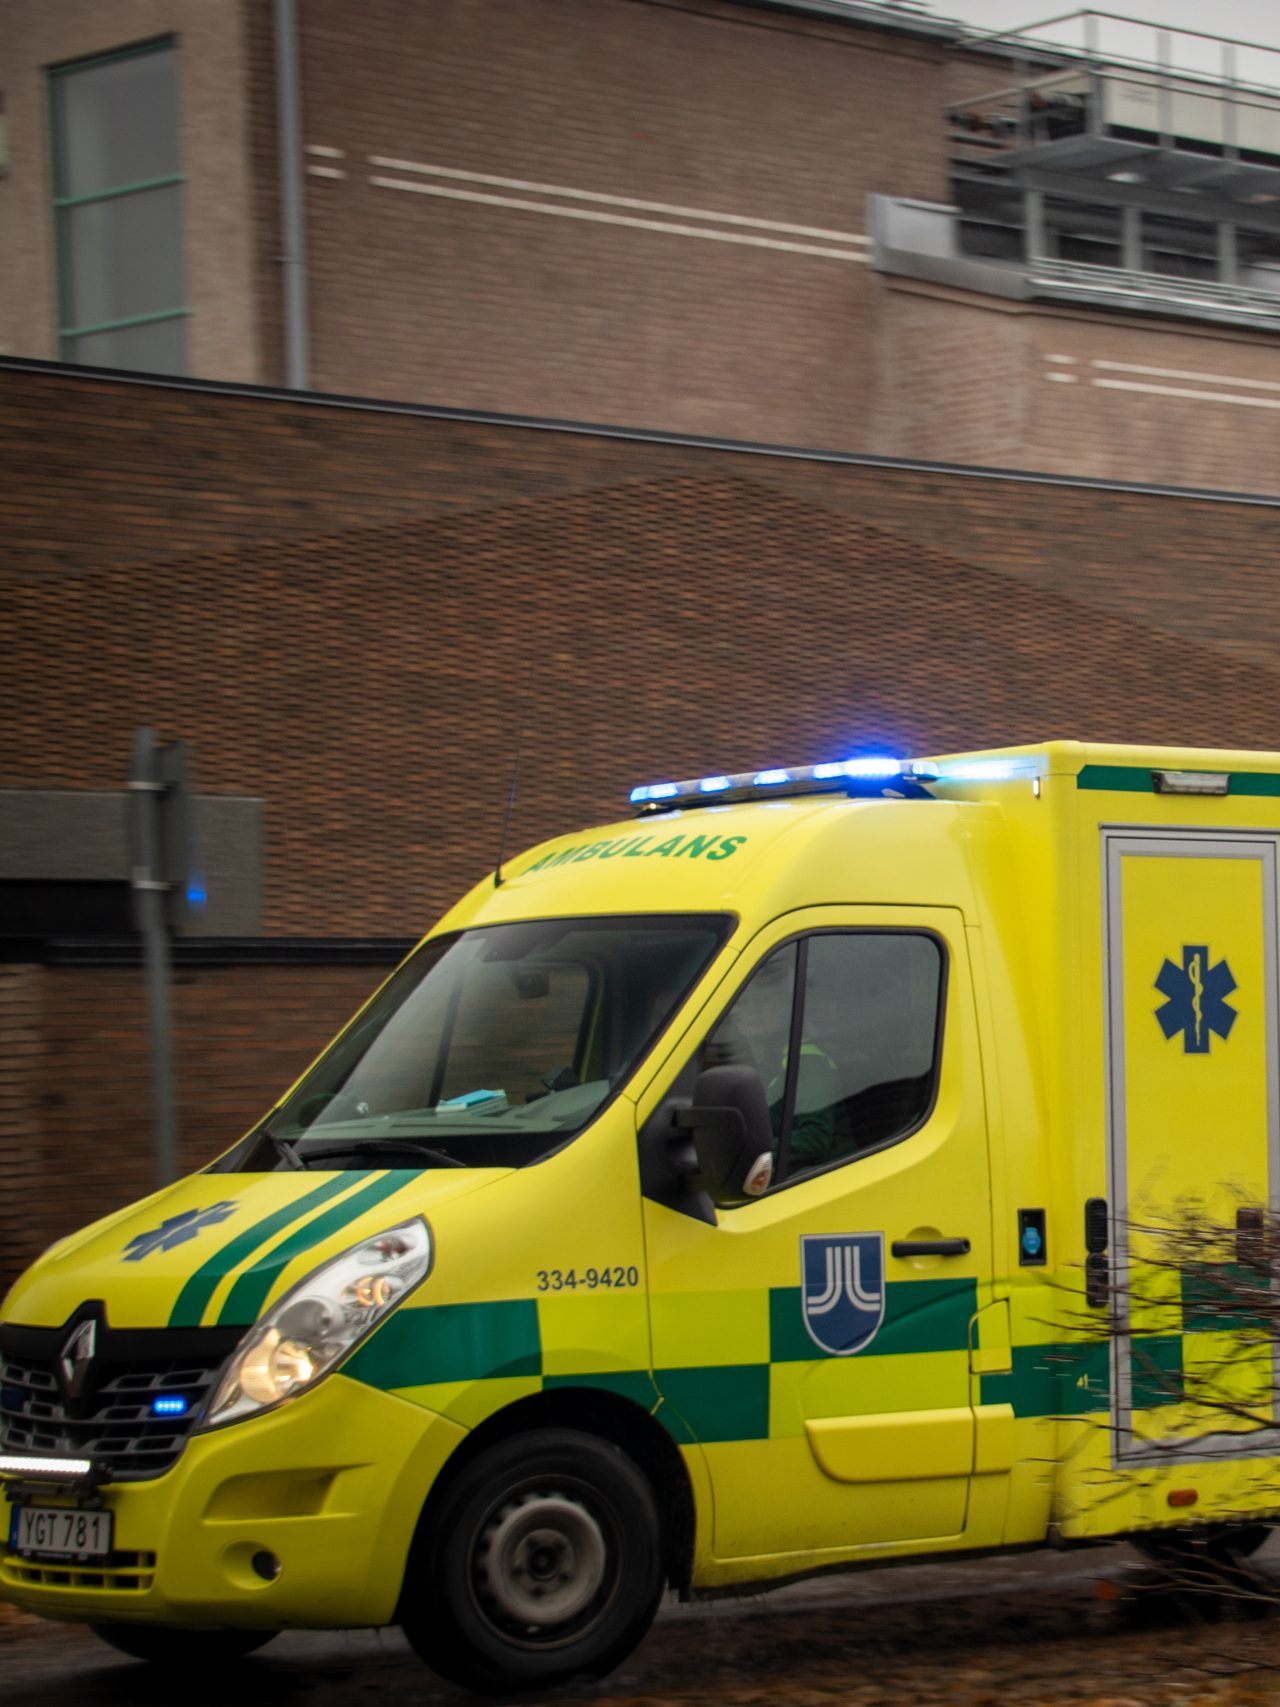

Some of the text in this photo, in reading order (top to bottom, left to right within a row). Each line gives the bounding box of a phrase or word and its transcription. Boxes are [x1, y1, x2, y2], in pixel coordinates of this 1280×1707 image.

[520, 835, 747, 876] AMBULANS
[536, 1266, 639, 1291] 334-9420
[25, 1512, 100, 1550] YGT 781
